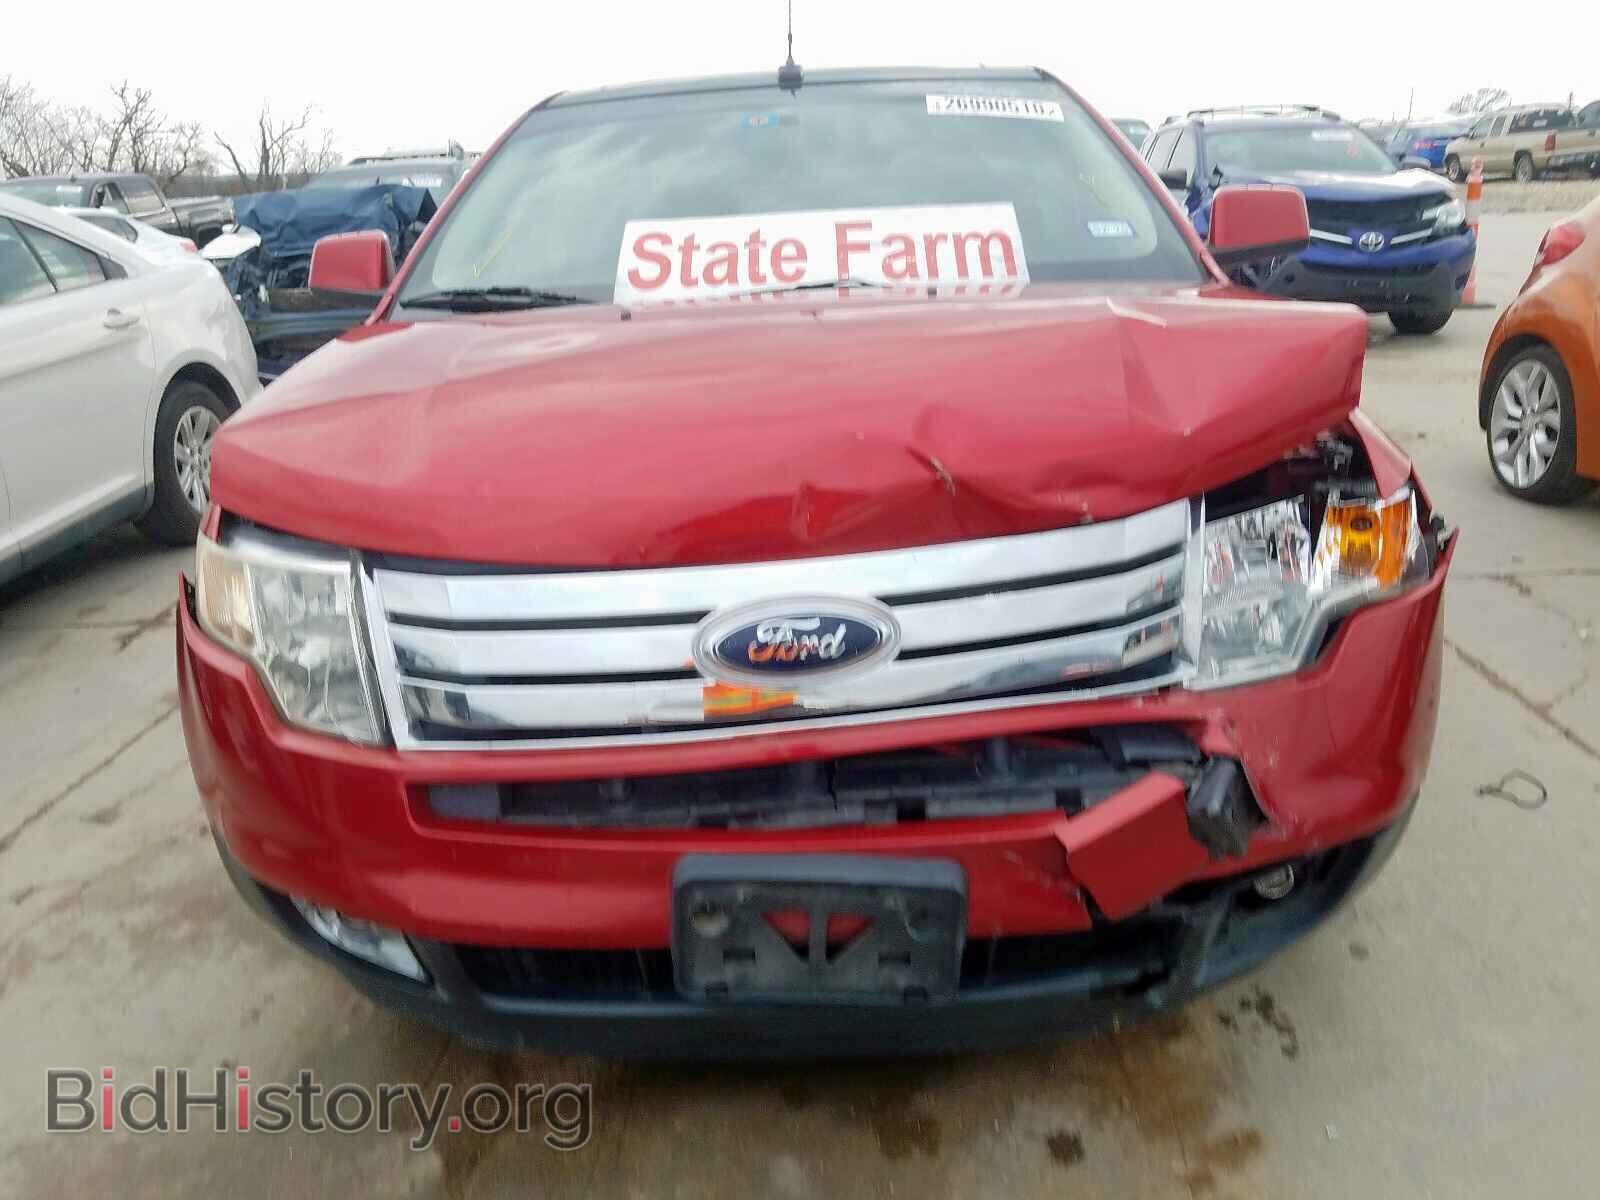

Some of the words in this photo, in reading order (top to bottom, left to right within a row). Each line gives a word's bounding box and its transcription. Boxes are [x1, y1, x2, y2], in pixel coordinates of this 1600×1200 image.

[627, 227, 808, 291] State
[834, 219, 1018, 282] Farm
[747, 617, 847, 662] Ford
